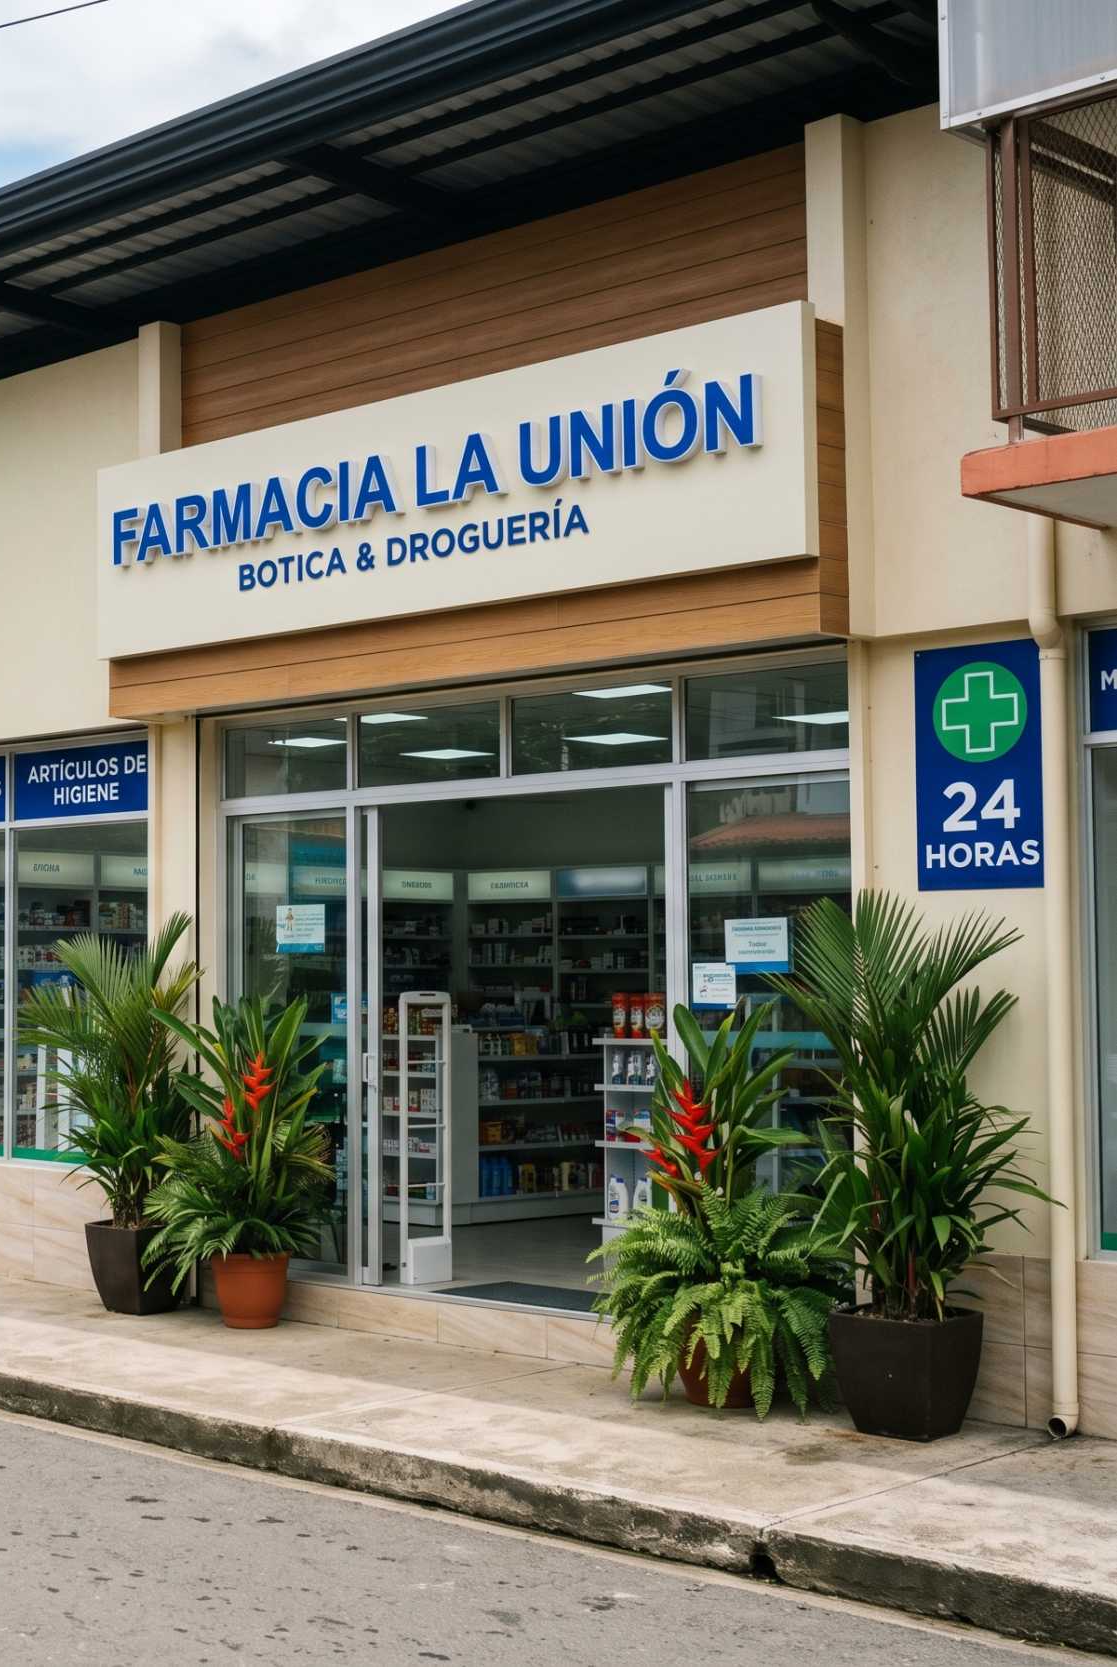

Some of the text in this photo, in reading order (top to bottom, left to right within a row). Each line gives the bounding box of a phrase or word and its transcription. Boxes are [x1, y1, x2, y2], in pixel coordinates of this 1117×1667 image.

[113, 368, 754, 566] FARMACIA LA UNIÓN
[238, 498, 590, 592] BOTICA & DROGUERÍA
[27, 753, 147, 785] ARTÍCULOS DE
[53, 782, 120, 806] HIGIENE
[942, 778, 1021, 833] 24
[925, 839, 1040, 869] HORAS
